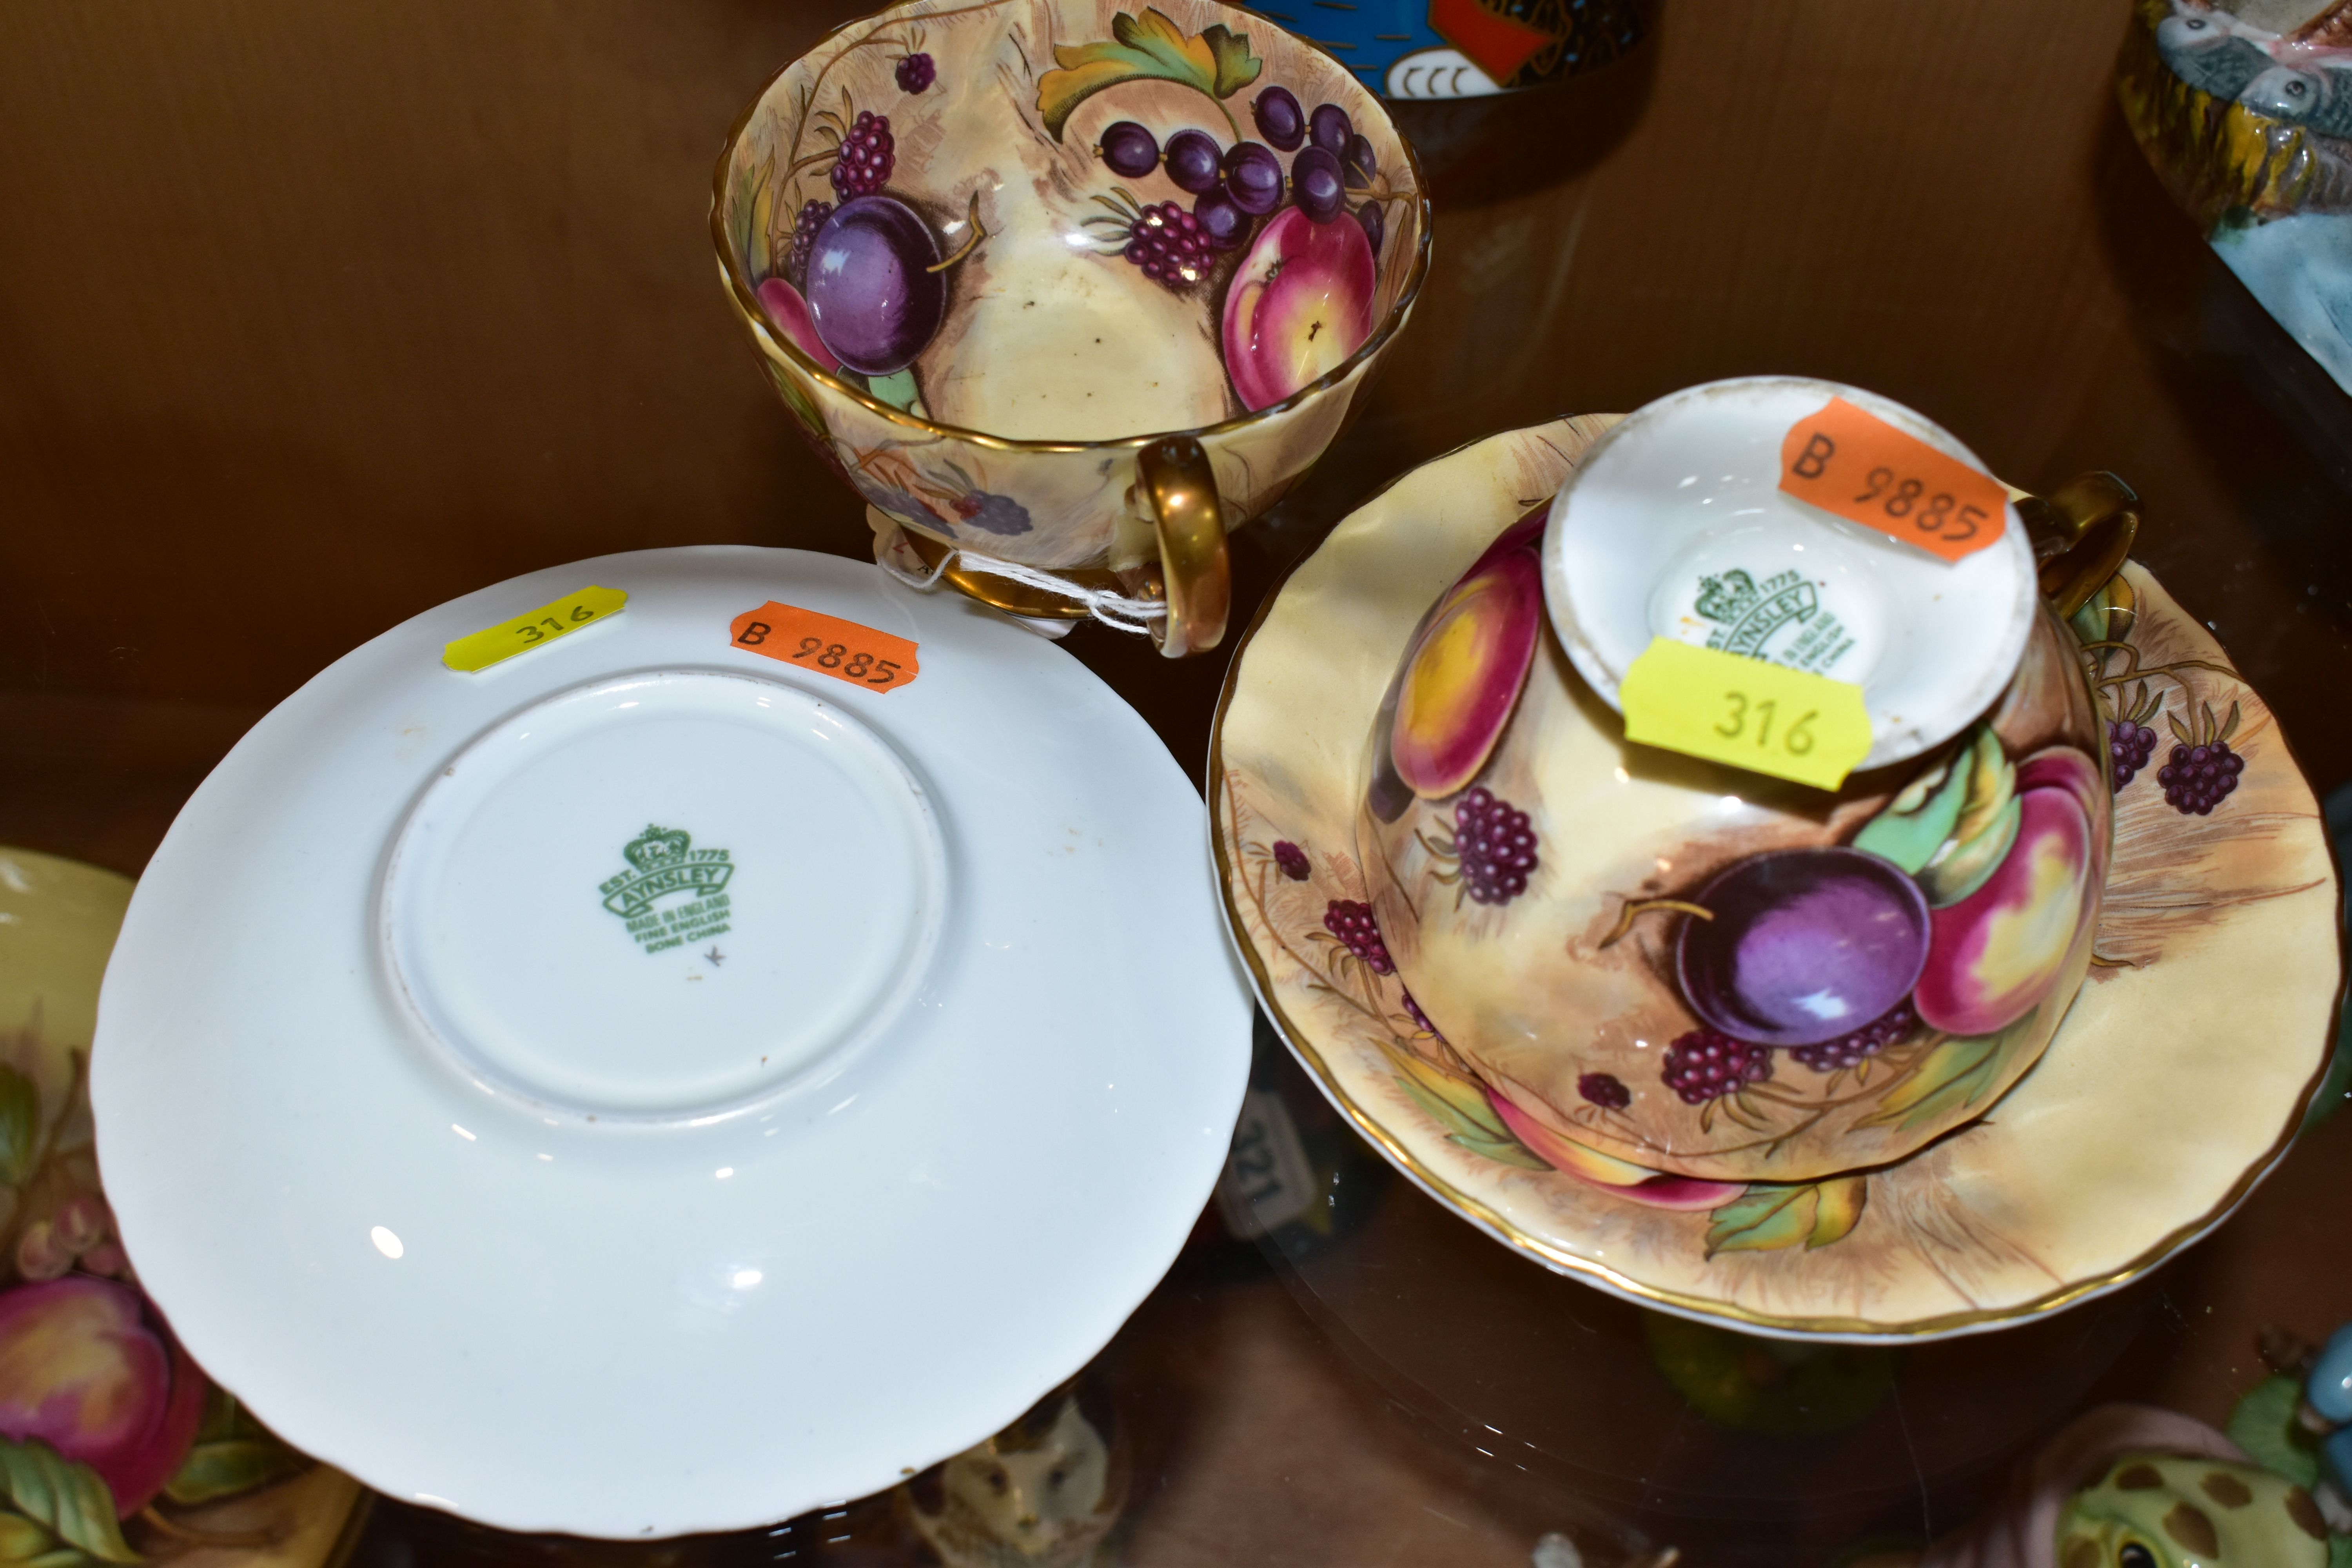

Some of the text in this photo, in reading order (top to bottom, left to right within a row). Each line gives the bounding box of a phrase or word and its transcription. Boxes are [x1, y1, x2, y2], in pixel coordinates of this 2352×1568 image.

[1792, 432, 1989, 541] B 9885
[516, 605, 594, 644] 316
[737, 621, 901, 683] B 9885
[1714, 690, 1820, 757] 316
[689, 849, 730, 862] 1775
[622, 867, 721, 908] AYNSLEY
[671, 909, 731, 933] ENGLISH
[687, 923, 731, 942] CHINA
